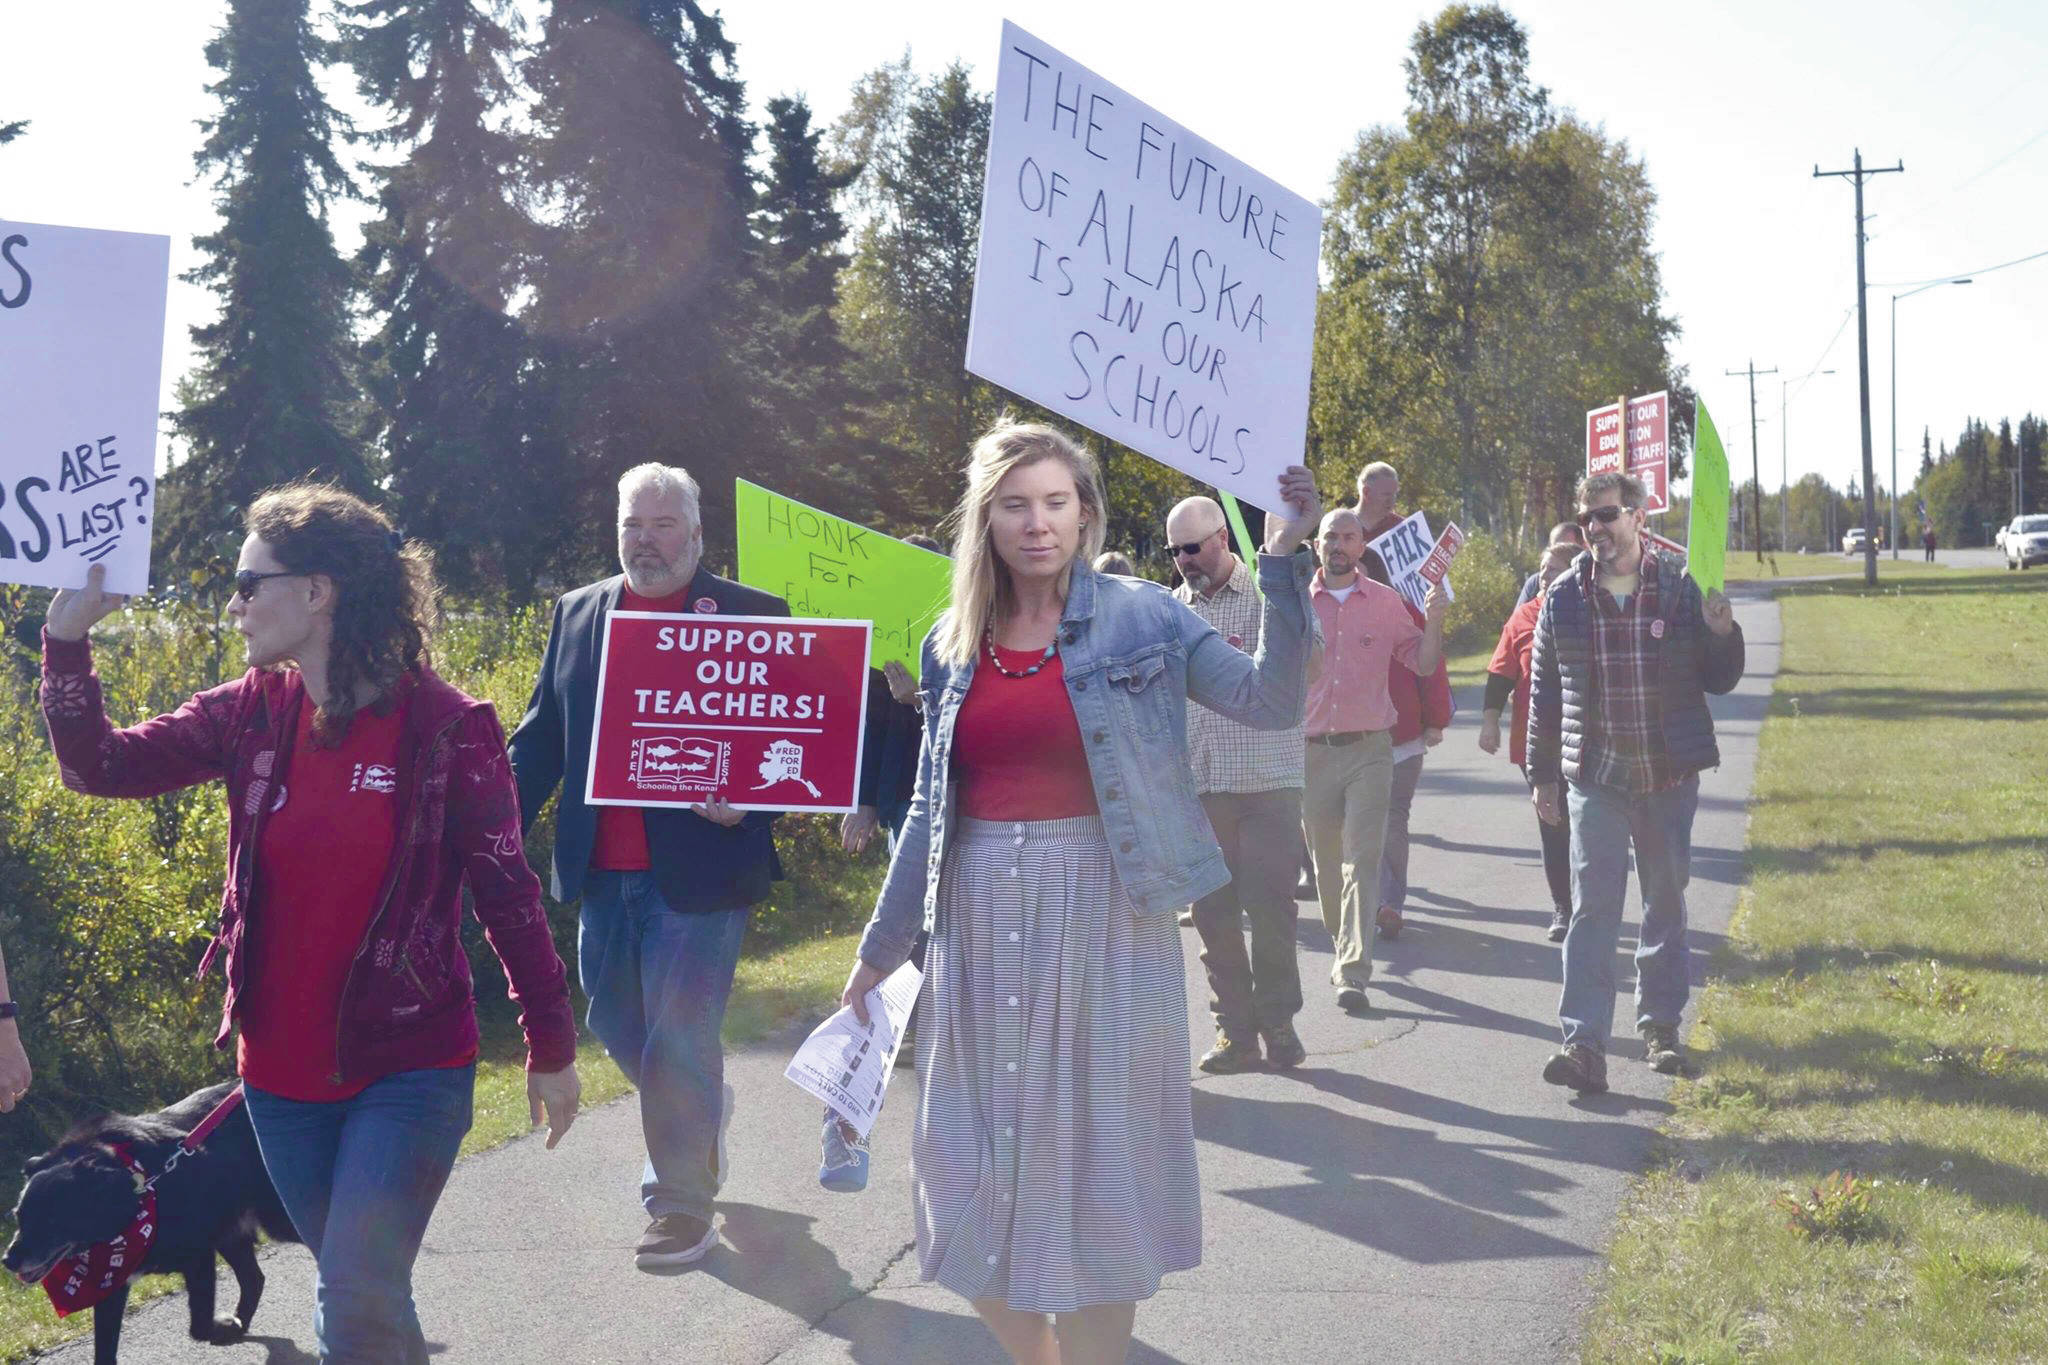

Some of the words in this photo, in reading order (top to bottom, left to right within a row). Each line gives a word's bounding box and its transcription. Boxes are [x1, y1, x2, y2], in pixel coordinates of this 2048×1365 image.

[1013, 47, 1114, 161] THE
[1136, 122, 1289, 262] FUTURE
[1018, 157, 1071, 218] OF
[1078, 189, 1269, 344] ALASKA
[1028, 238, 1074, 297] IS
[1097, 277, 1144, 333] IN
[1162, 322, 1229, 396] OUR
[1064, 331, 1251, 476] SCHOOLS
[1595, 408, 1636, 433] SUPPT
[1637, 403, 1658, 421] OUR
[1600, 425, 1652, 451] EDUTION
[1632, 441, 1665, 462] STAFF!
[59, 435, 122, 492] ARE
[57, 475, 150, 549] LAST?
[767, 495, 869, 560] HONK
[1379, 520, 1432, 576] FAIR
[655, 626, 817, 656] SUPPORT
[696, 659, 769, 686] OUR
[634, 689, 826, 720] TEACHERS!
[775, 747, 800, 756] #RED
[780, 757, 799, 765] FOR
[787, 766, 799, 775] ED
[637, 782, 677, 792] Schooling
[679, 783, 692, 791] the
[694, 784, 718, 792] Kenai
